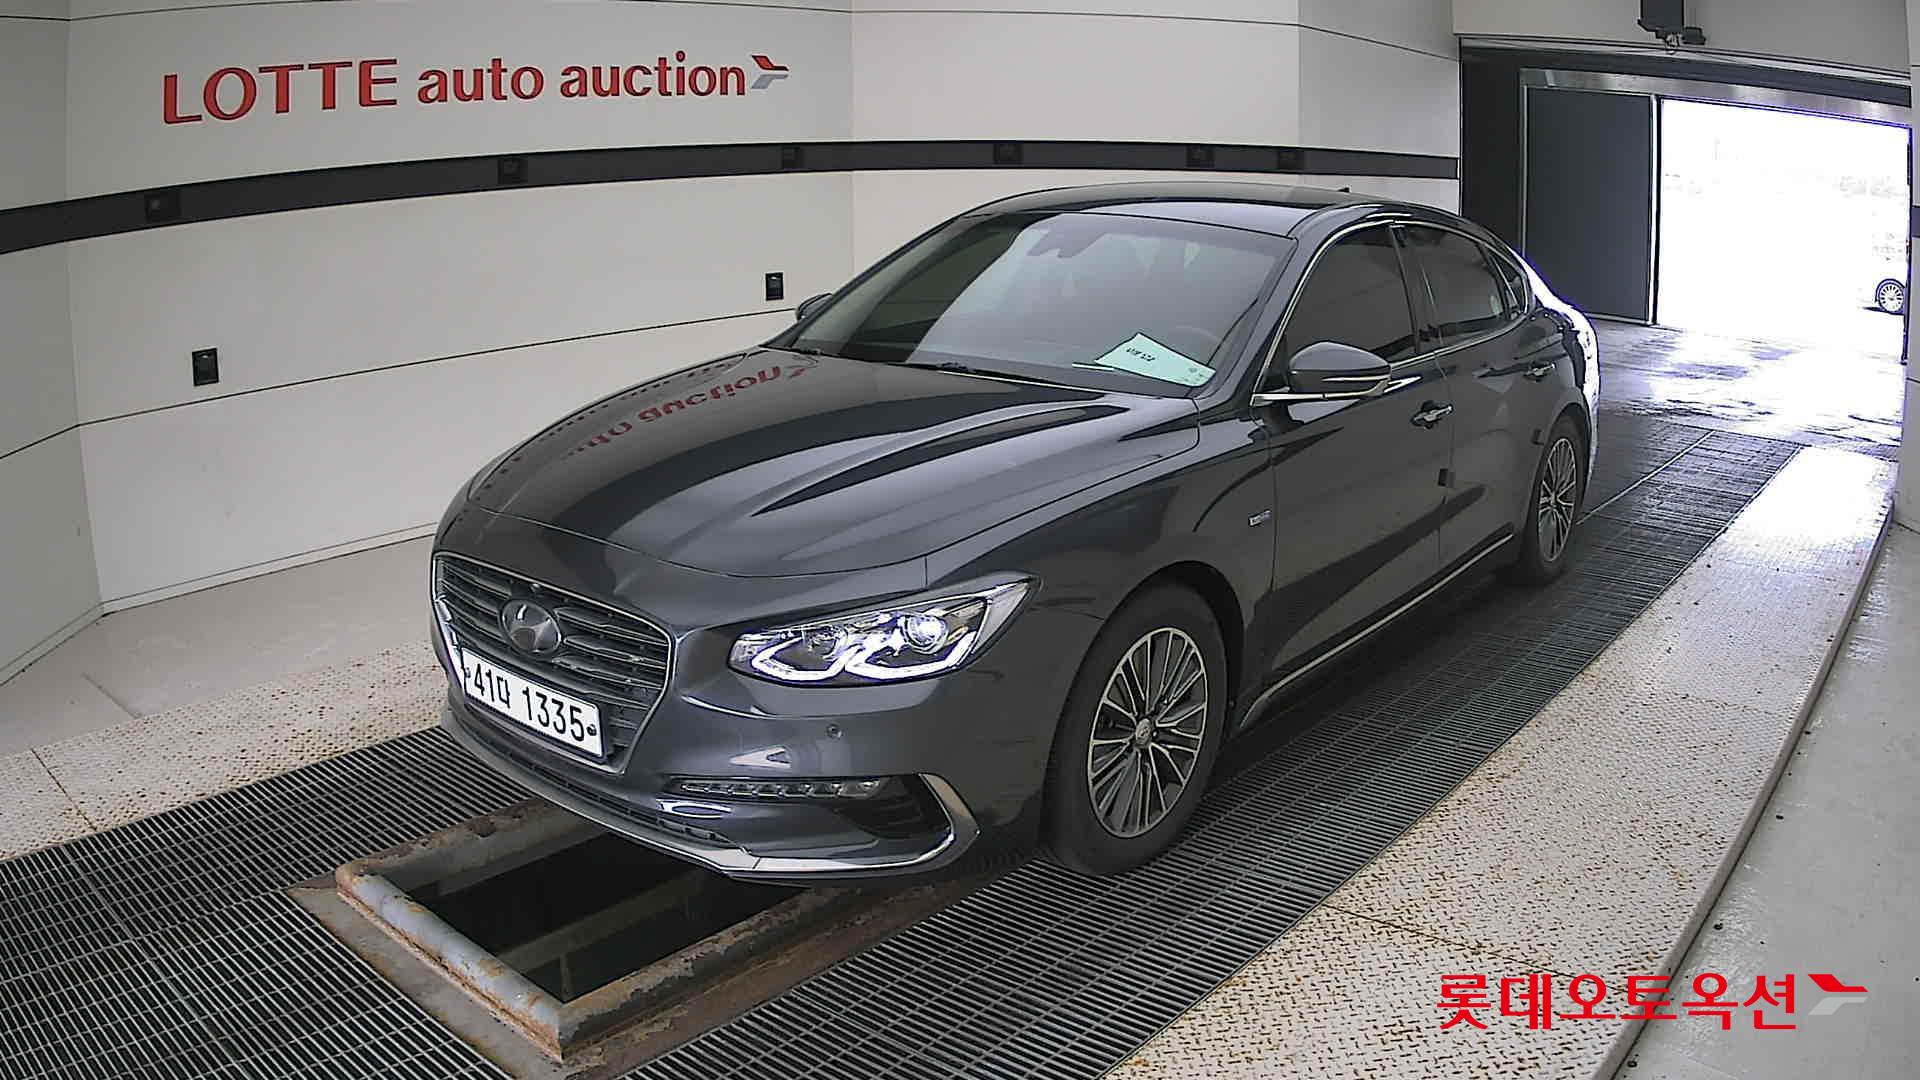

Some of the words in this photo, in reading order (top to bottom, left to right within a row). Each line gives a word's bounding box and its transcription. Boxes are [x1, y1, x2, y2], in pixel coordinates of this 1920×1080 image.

[162, 59, 398, 125] LOTTE
[417, 58, 545, 104] auto
[560, 51, 746, 97] auction
[522, 686, 585, 742] 1335
